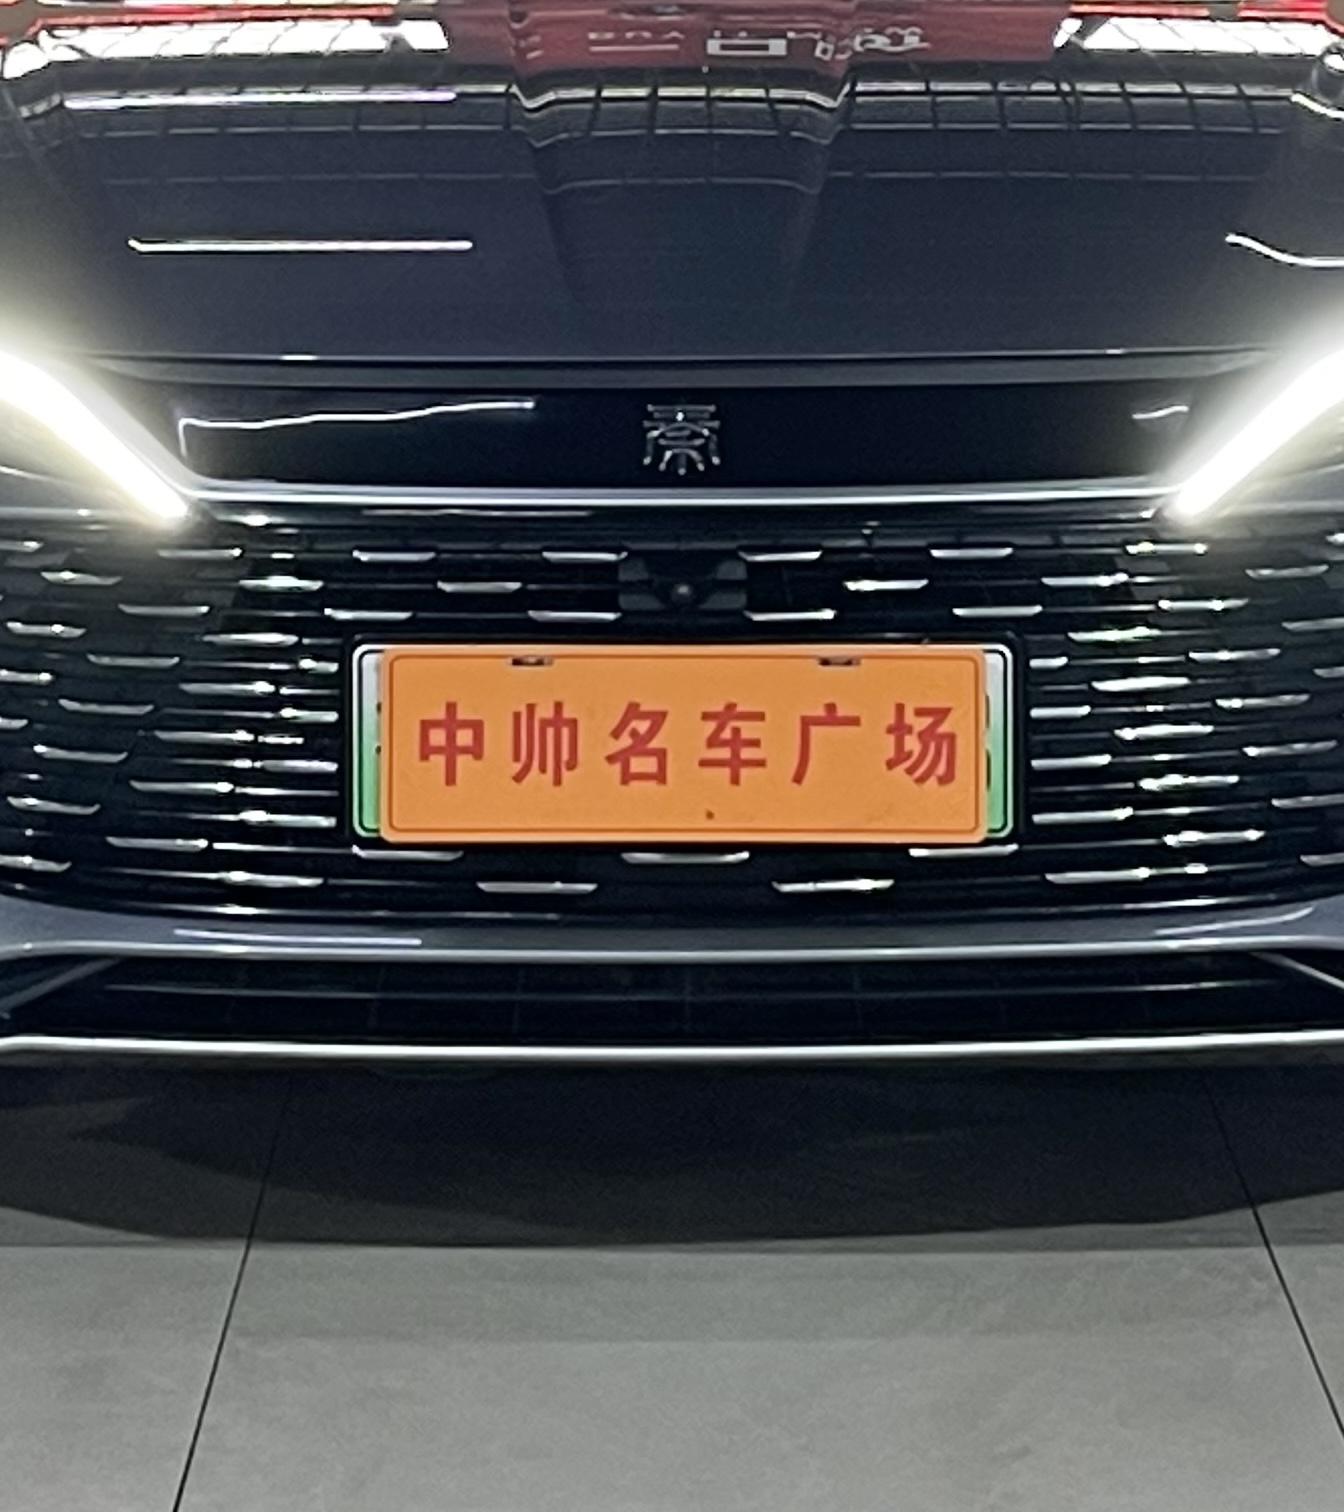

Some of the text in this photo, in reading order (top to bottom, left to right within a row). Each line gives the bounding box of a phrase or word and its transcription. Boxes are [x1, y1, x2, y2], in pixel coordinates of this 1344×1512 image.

[418, 699, 958, 788] 中帅名车广场
